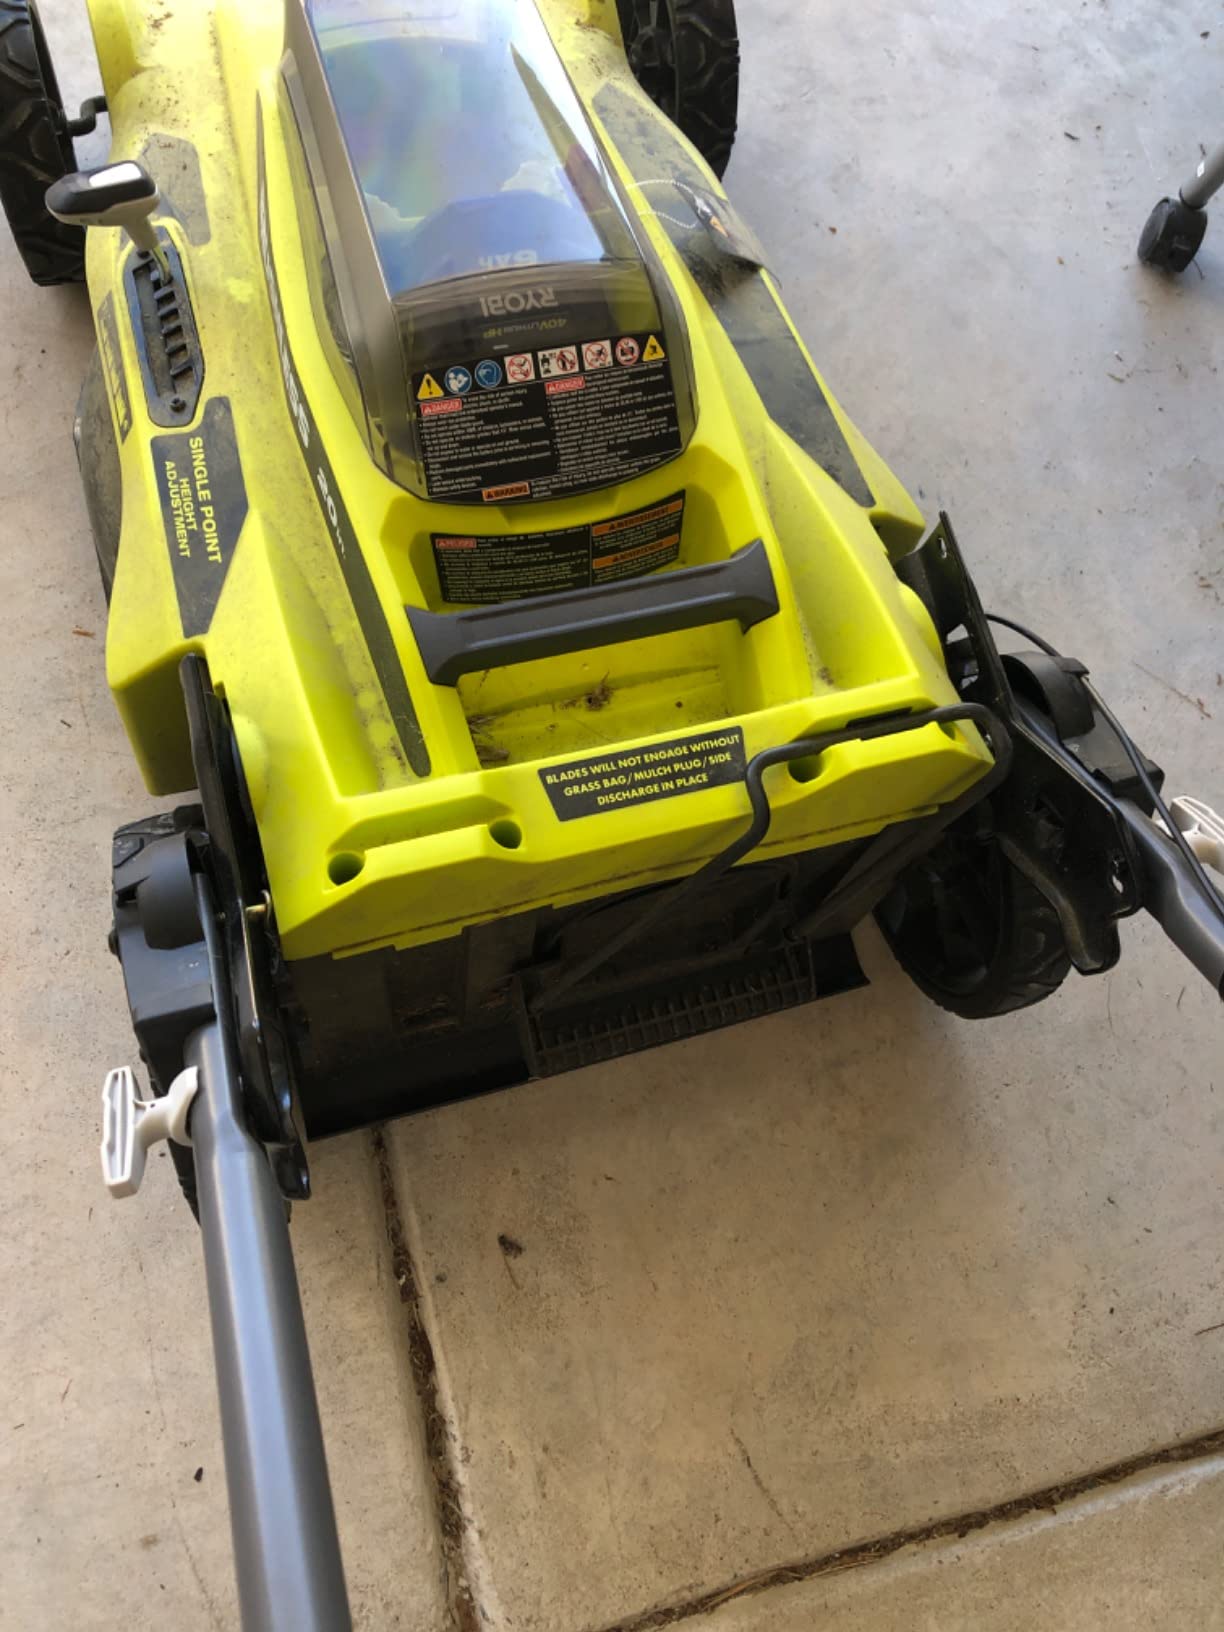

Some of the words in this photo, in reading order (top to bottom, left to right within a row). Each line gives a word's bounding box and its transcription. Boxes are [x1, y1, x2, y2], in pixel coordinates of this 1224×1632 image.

[479, 287, 559, 318] RYOBI
[165, 460, 190, 558] ADJUSTMENT
[179, 477, 198, 531] HEIGHT
[189, 437, 211, 502] SINGLE
[200, 505, 222, 563] POINT
[317, 467, 337, 527] 20
[546, 768, 588, 785] BLADES
[589, 762, 617, 778] WILL
[618, 756, 643, 770] NOT
[643, 745, 690, 764] ENGAGE
[689, 734, 741, 754] WITHOUT
[563, 781, 601, 797] GRASS
[597, 784, 660, 806] DISCHARGE
[662, 780, 675, 792] IN
[676, 773, 709, 789] PLACE
